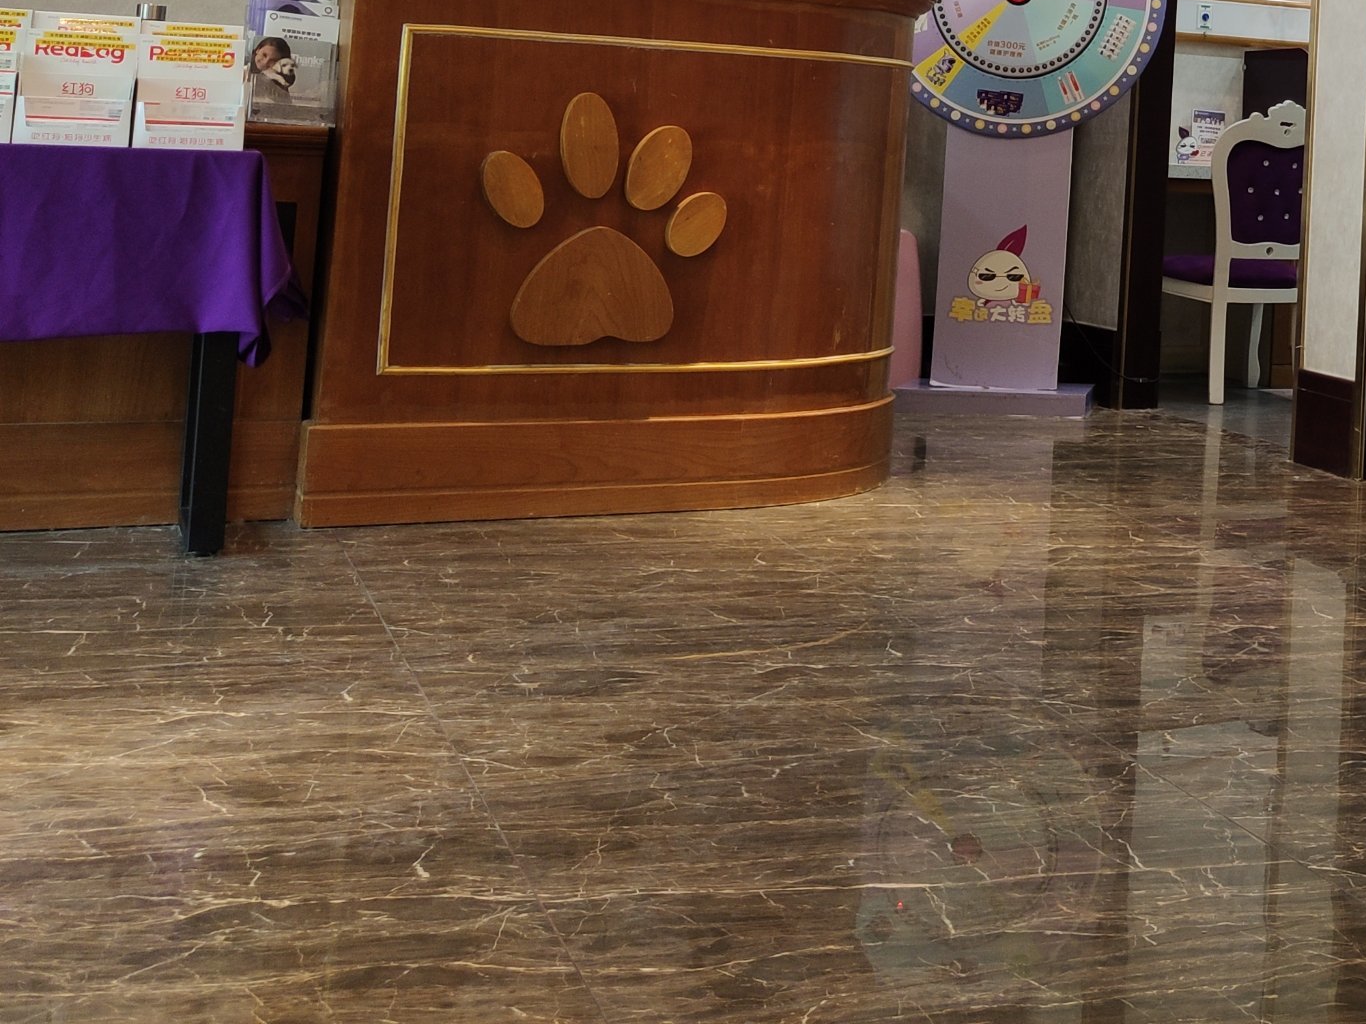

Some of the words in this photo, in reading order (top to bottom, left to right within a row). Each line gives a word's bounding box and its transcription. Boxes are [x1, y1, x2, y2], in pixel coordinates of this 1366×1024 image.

[62, 82, 95, 96] 红狗
[175, 87, 207, 100] 红狗
[949, 296, 1053, 325] 幸运大转盘
